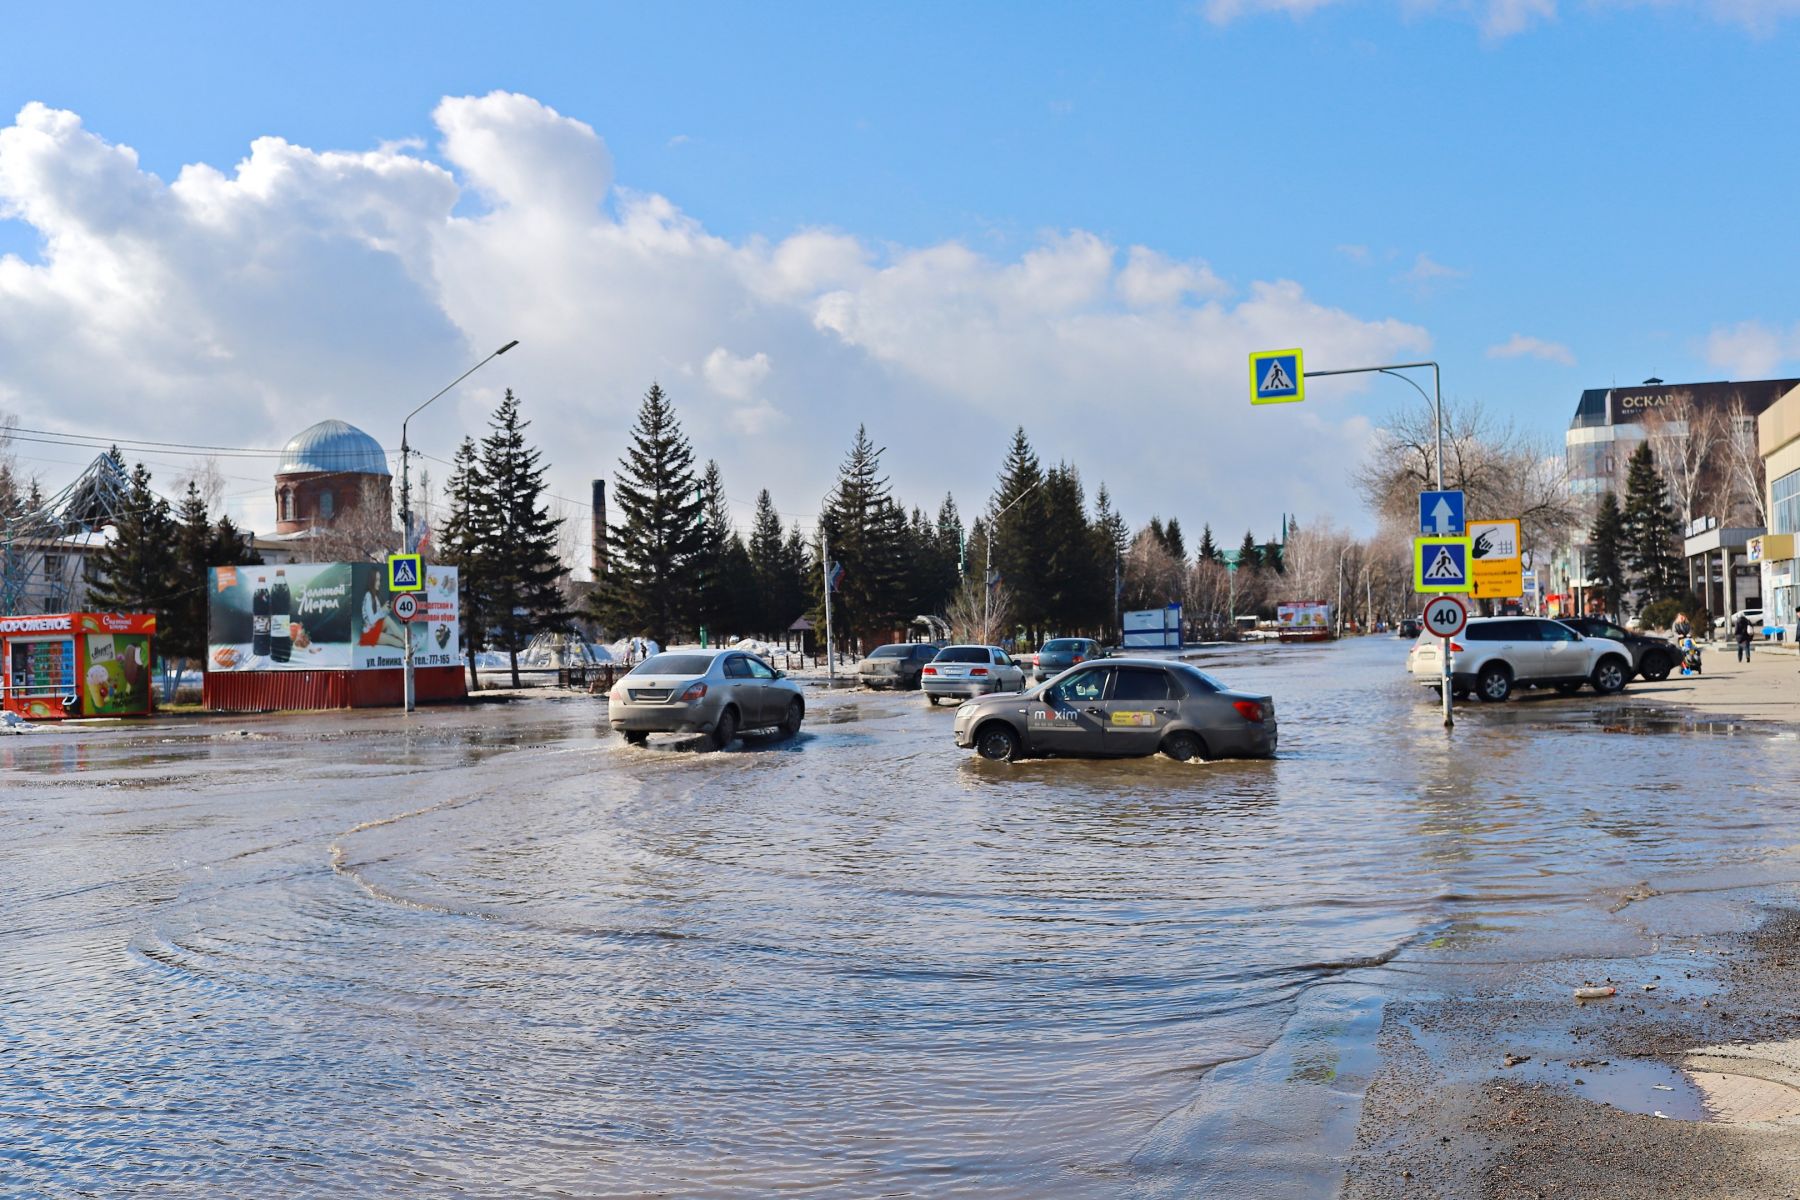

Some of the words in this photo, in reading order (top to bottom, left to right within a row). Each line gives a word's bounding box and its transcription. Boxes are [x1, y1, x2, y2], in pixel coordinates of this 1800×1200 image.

[296, 584, 345, 602] Золотой
[297, 598, 340, 616] Марал
[399, 601, 413, 612] 40
[1433, 609, 1457, 625] 40
